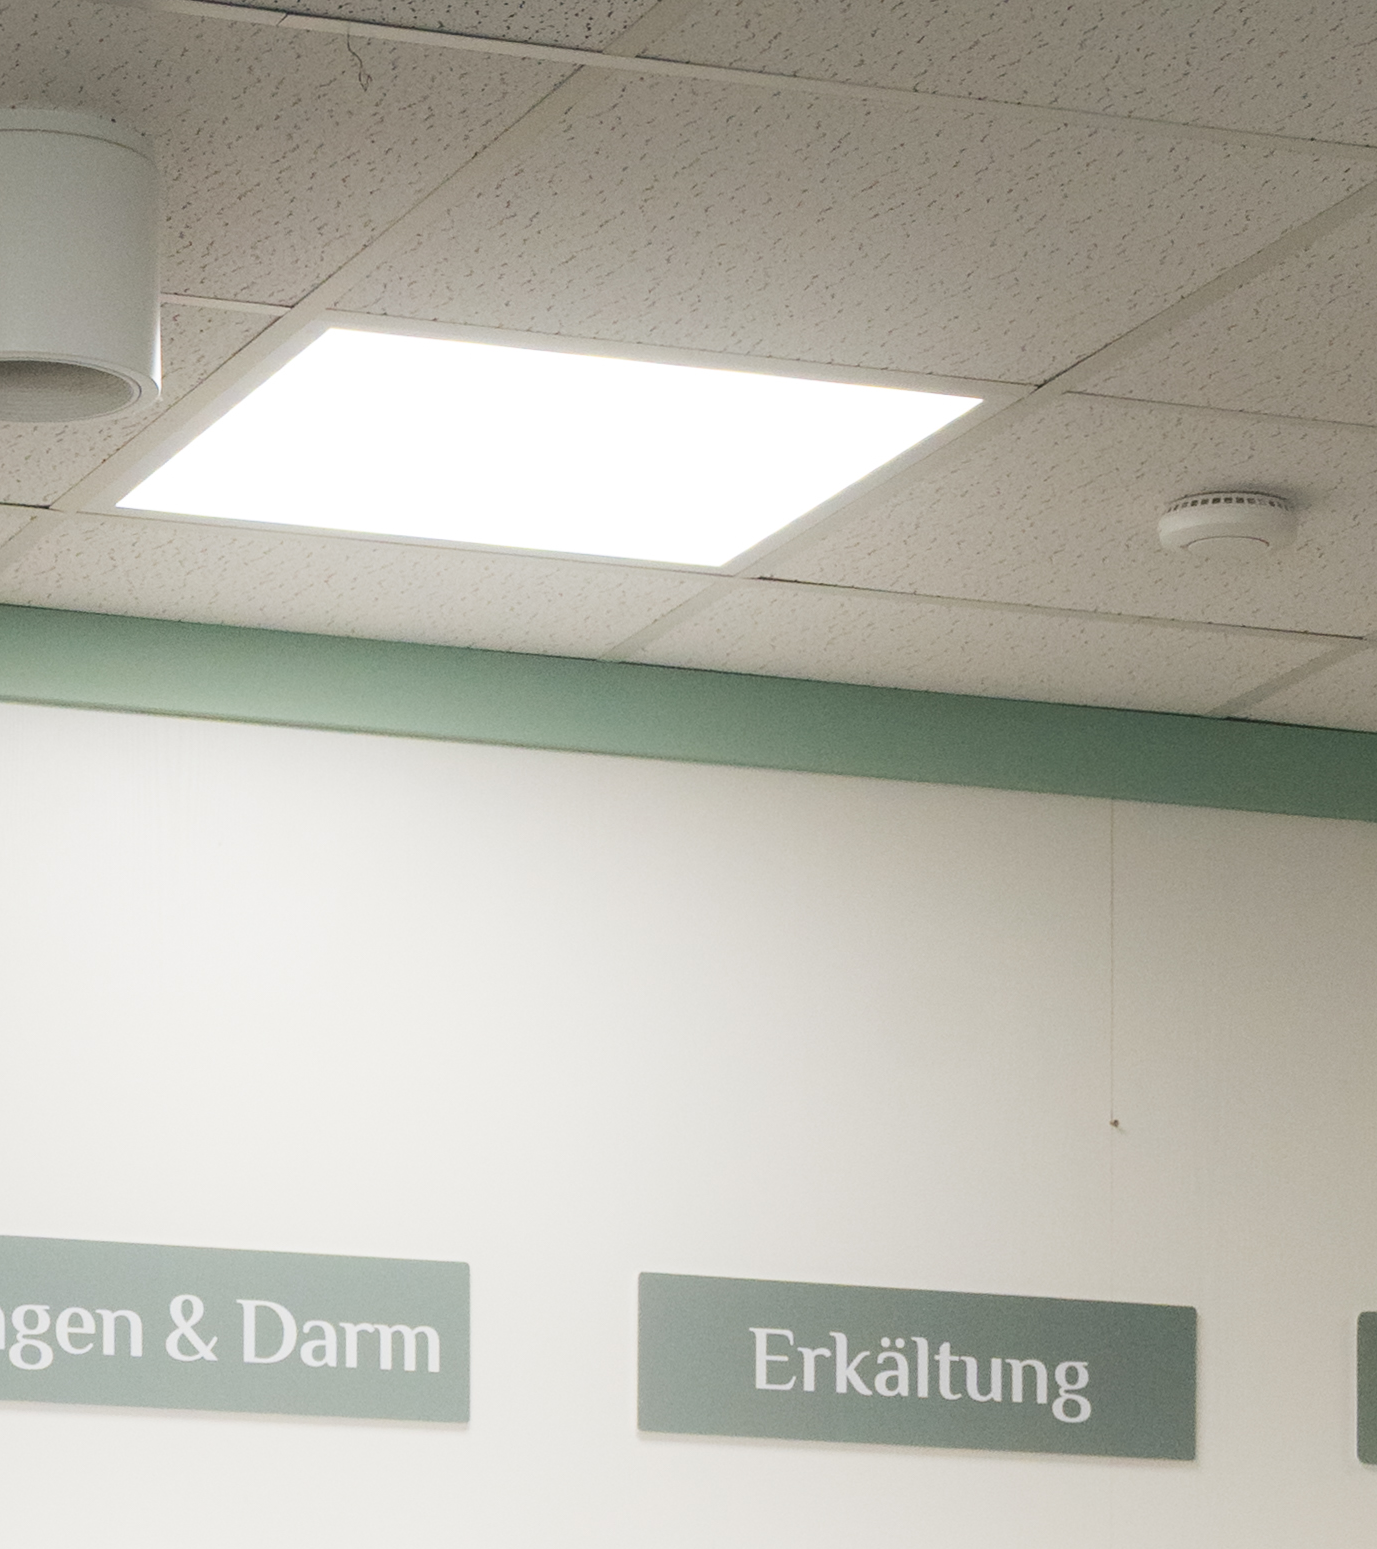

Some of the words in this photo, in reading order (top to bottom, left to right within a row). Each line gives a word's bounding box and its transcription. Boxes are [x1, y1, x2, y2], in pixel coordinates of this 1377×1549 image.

[165, 1294, 219, 1362] &
[236, 1298, 441, 1373] Darm
[748, 1327, 1092, 1423] Erkältung
